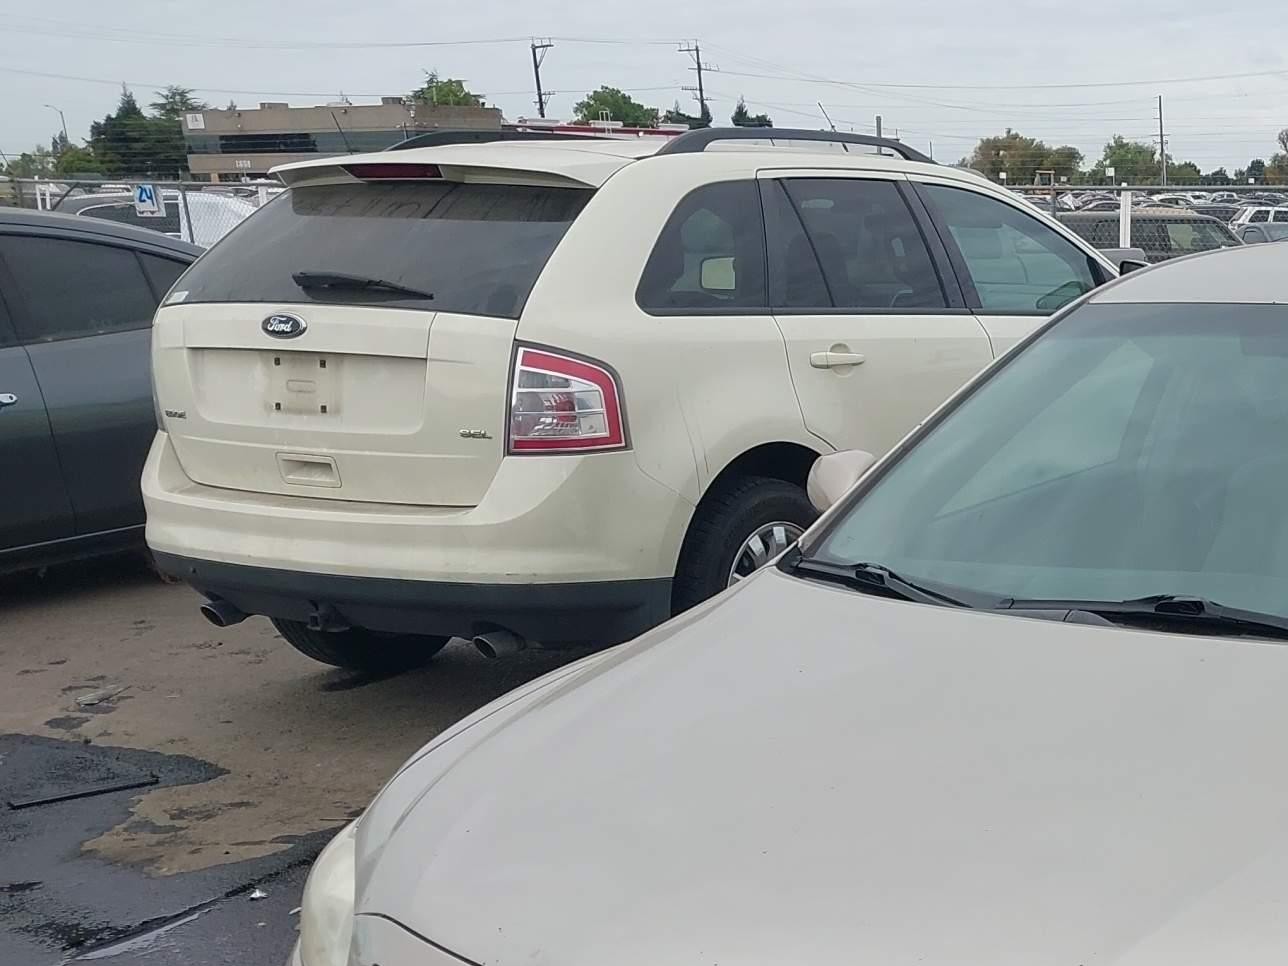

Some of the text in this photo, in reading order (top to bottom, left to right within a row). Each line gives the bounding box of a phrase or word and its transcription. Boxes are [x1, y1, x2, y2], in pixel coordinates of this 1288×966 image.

[138, 185, 155, 207] 24
[267, 317, 293, 332] Ford
[459, 429, 493, 440] SEL
